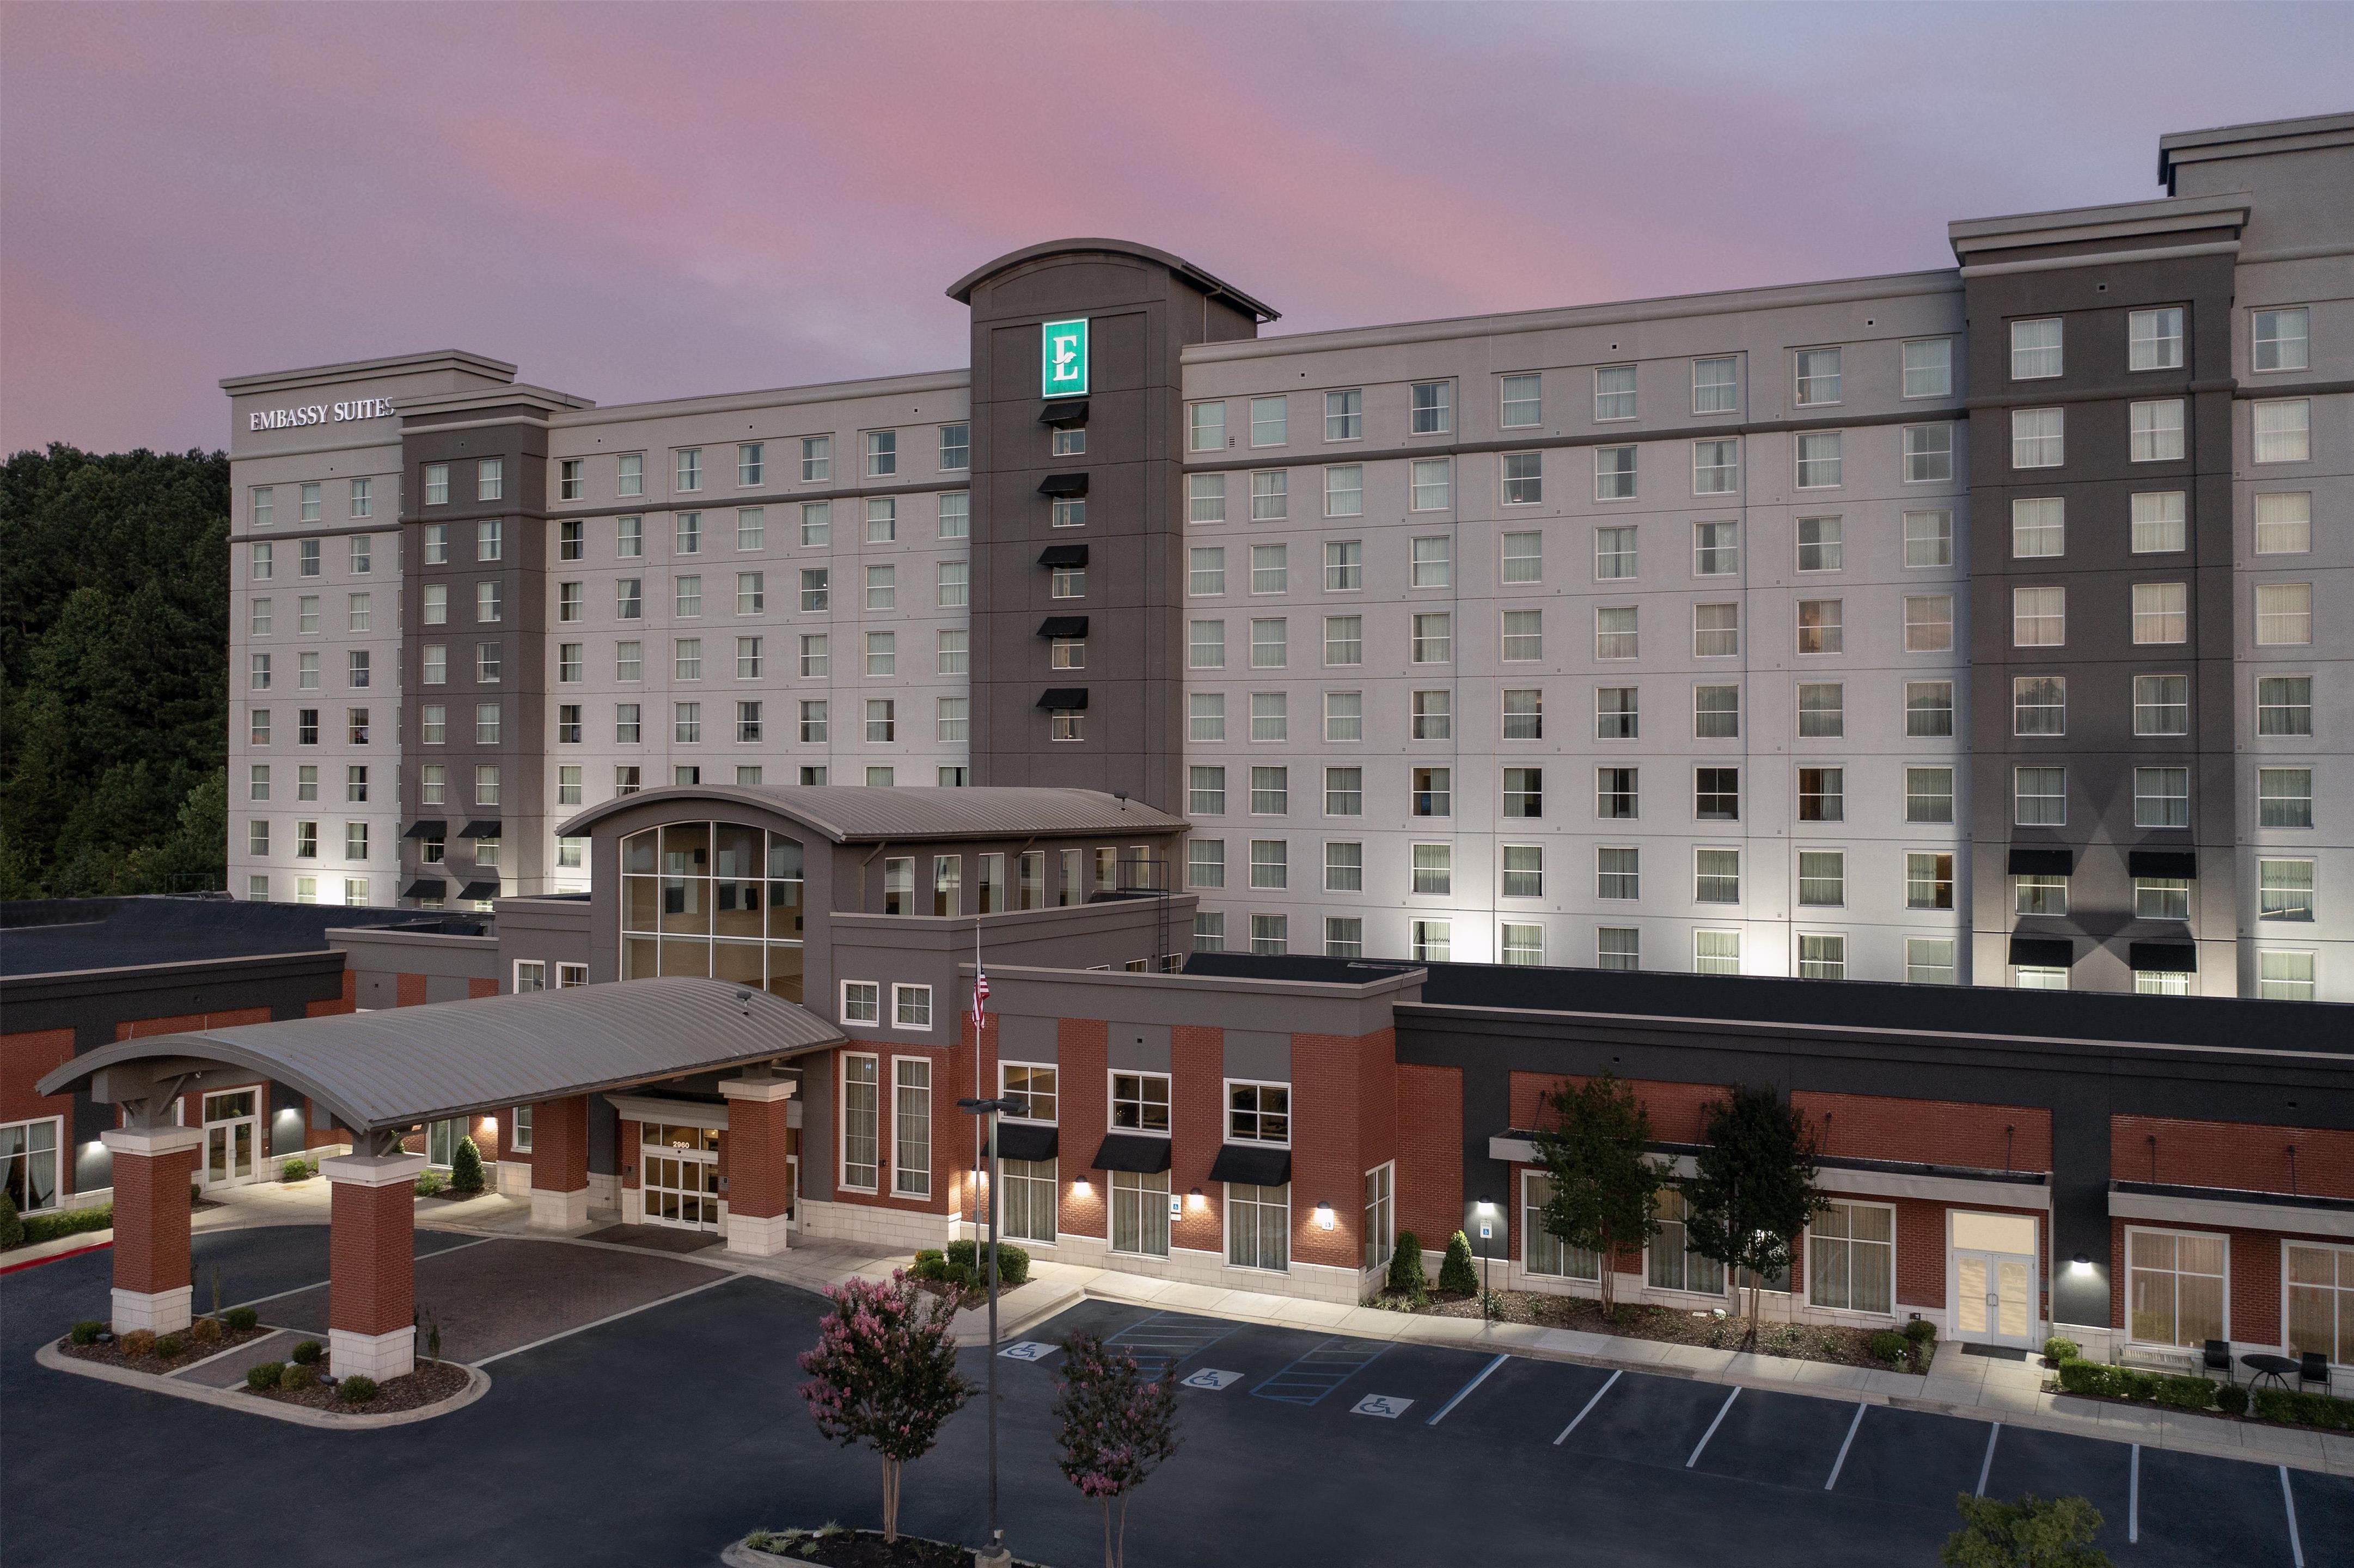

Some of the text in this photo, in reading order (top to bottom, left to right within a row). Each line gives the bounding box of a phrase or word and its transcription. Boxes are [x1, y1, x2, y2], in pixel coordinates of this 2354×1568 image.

[1052, 335, 1078, 381] E
[250, 396, 395, 431] EMBASSY SUITES
[672, 1141, 690, 1149] 2960
